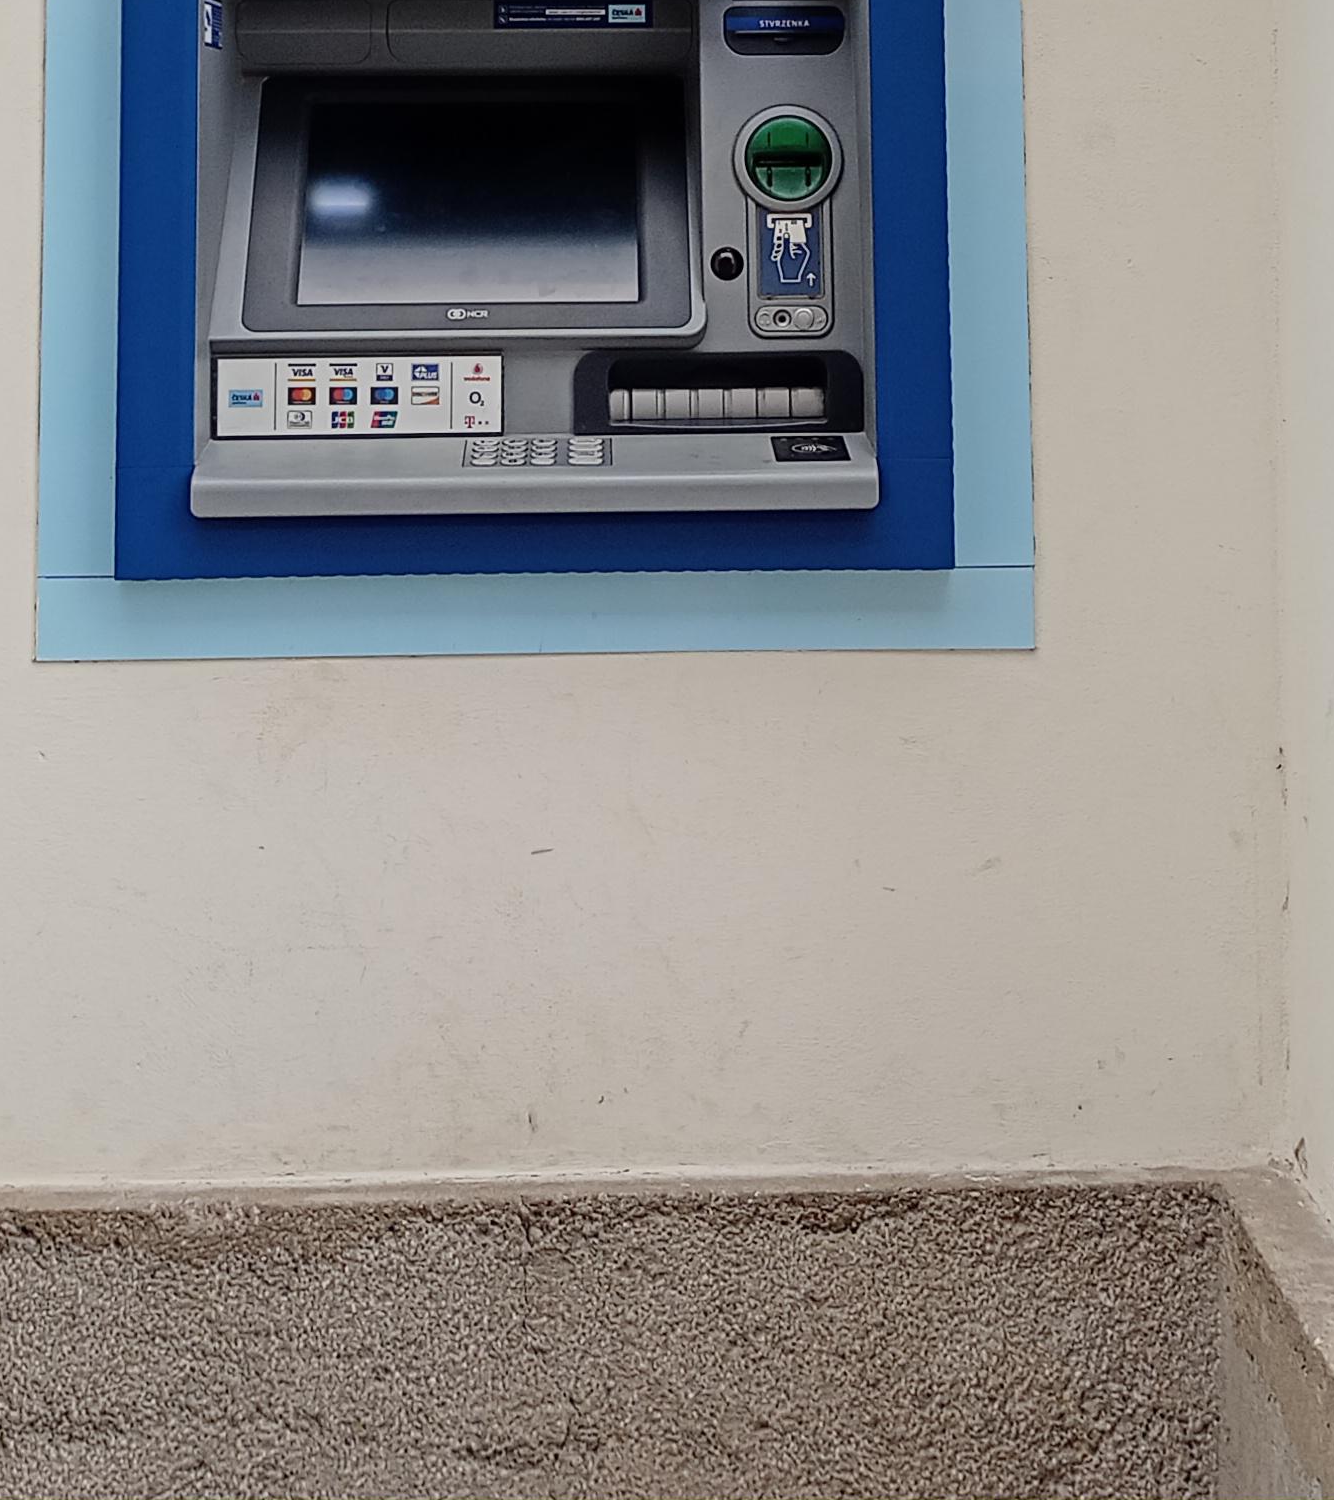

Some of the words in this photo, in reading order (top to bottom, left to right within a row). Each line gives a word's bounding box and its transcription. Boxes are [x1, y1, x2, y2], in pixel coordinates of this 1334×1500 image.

[291, 368, 314, 377] VISA
[333, 367, 354, 376] VISA
[419, 371, 438, 379] PLUS
